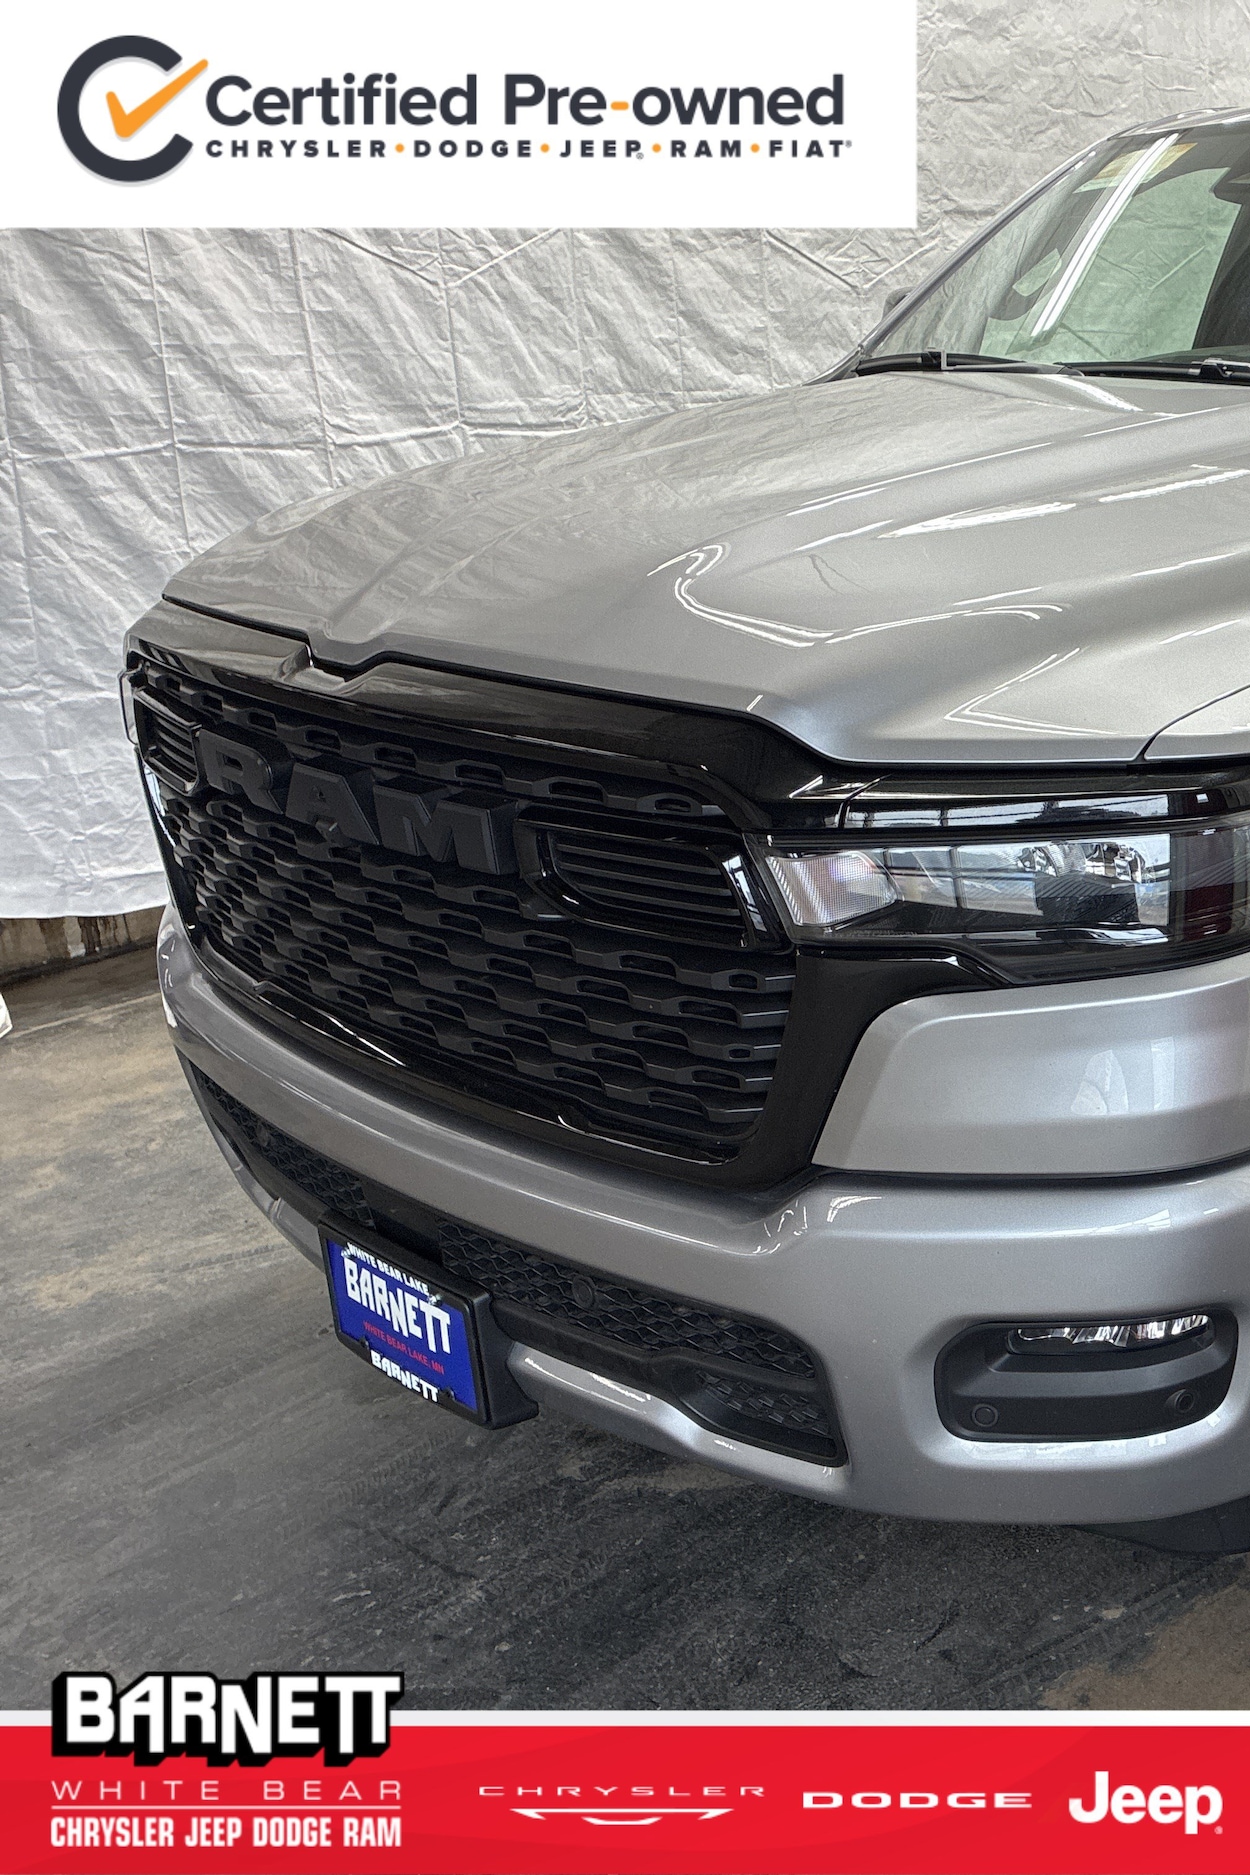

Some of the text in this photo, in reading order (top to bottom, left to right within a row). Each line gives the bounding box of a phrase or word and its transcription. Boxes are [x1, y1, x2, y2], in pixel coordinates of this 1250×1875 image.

[199, 727, 512, 876] RAM
[346, 1241, 430, 1296] WHITE BEAR LAKE
[343, 1256, 451, 1354] BARNETT
[363, 1320, 386, 1342] WHITE
[385, 1333, 408, 1355] BEAR
[430, 1359, 445, 1375] MN
[370, 1349, 439, 1403] BARNETT
